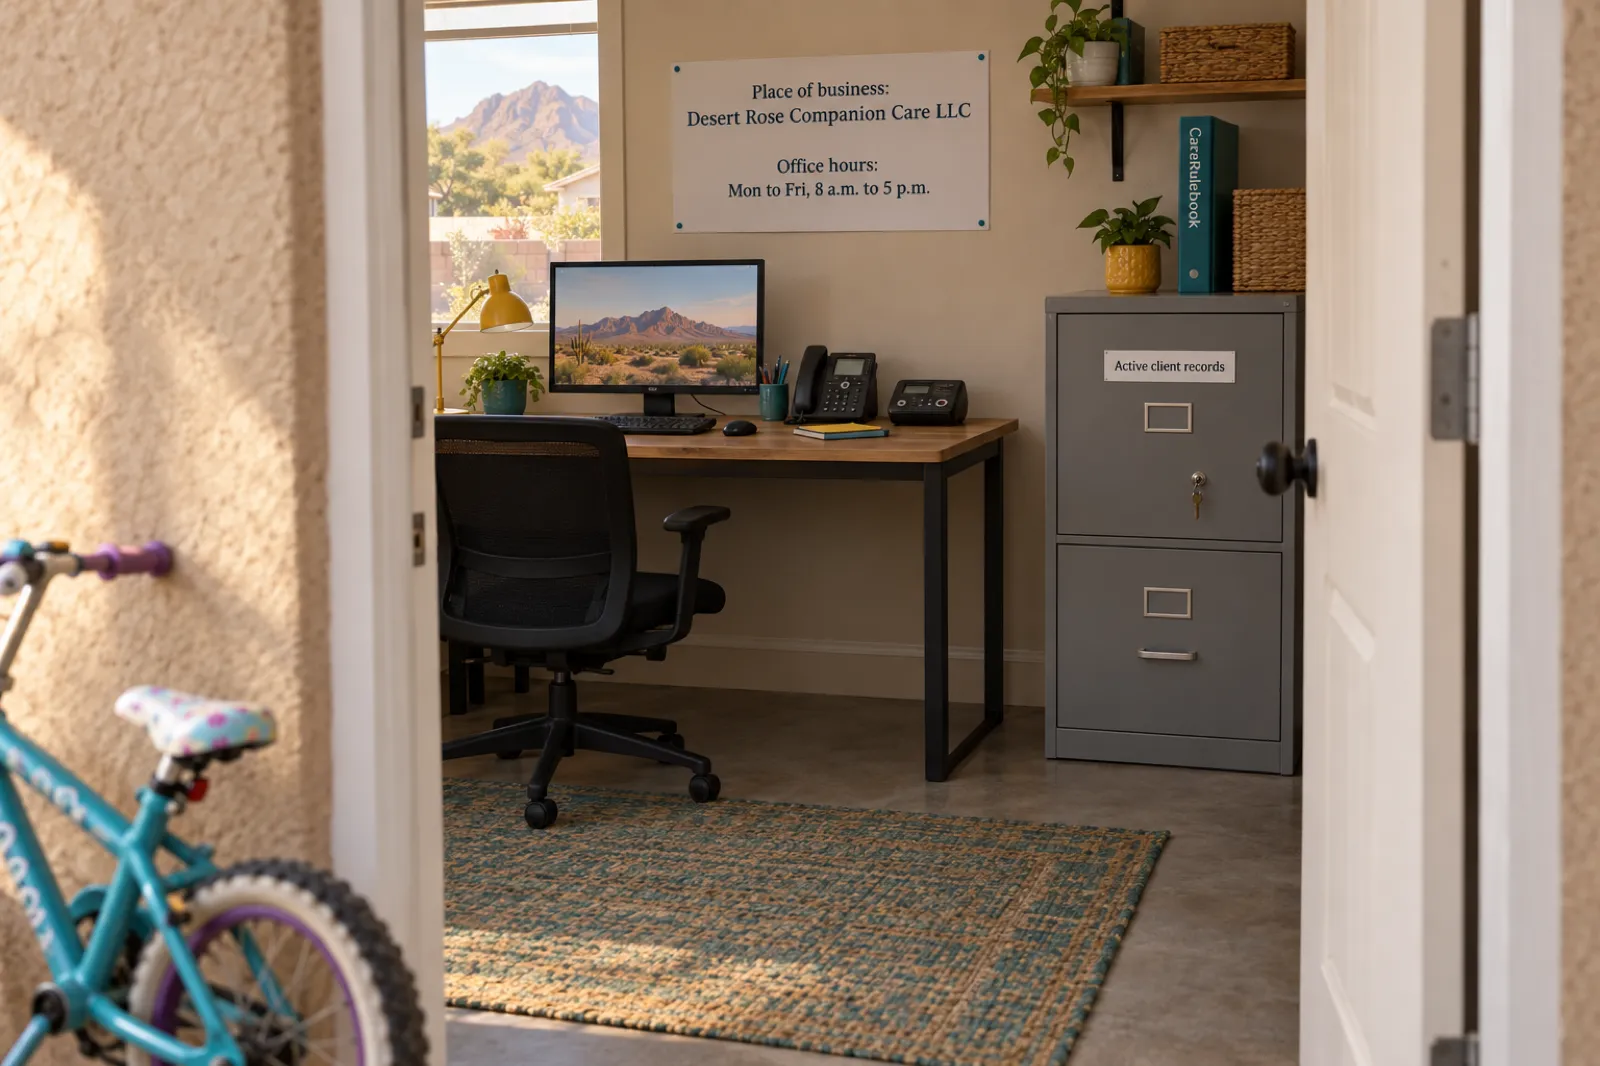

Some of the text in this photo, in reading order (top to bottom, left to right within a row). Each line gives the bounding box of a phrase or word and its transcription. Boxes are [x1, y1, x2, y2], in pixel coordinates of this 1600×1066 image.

[752, 81, 890, 100] Place of business:
[687, 102, 972, 127] Desert Rose Companion Care LLC
[776, 157, 878, 174] Office hours:
[1188, 127, 1202, 229] CareRulebook
[728, 180, 930, 200] Mon to Fri, 8 a.m. to 5 p.m.
[1114, 360, 1226, 373] Active client records
